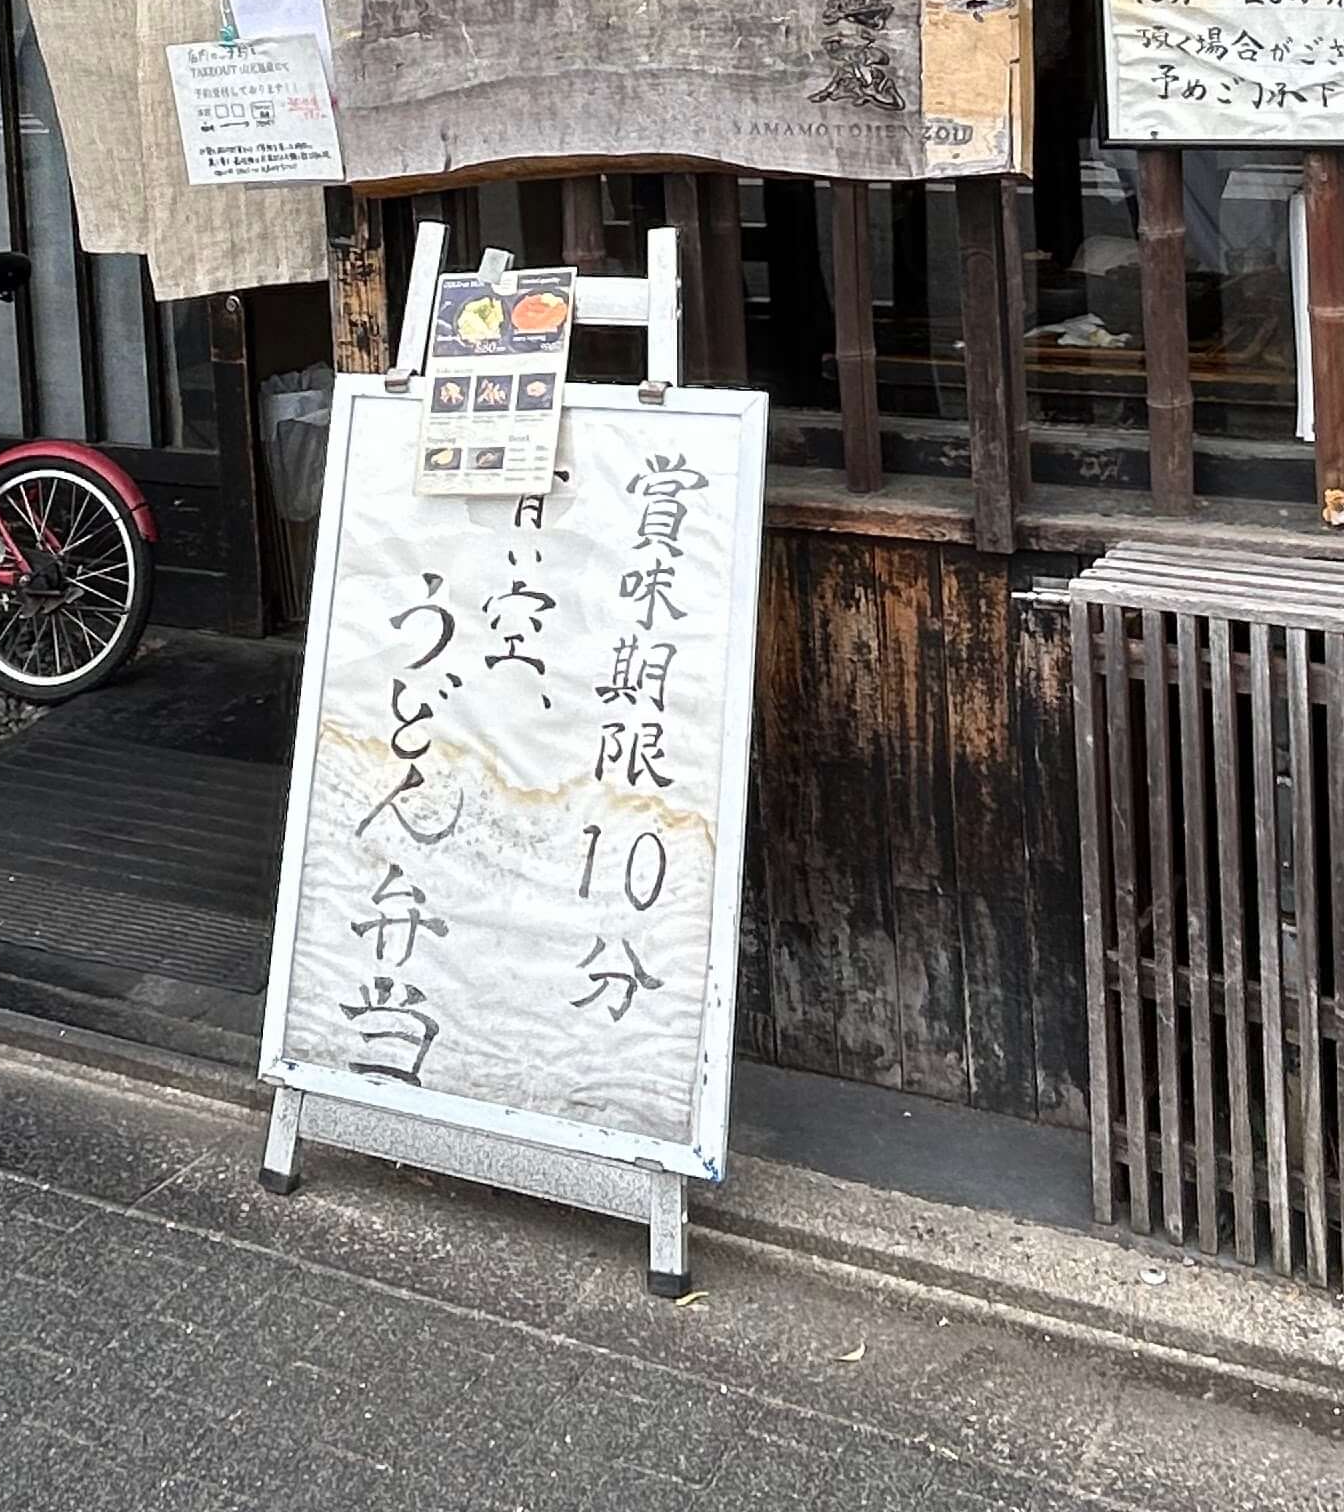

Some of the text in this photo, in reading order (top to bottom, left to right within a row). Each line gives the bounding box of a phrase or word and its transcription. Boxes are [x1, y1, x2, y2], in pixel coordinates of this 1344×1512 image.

[338, 572, 466, 1087] うどん弁当
[571, 453, 710, 1023] 賞味期限10分
